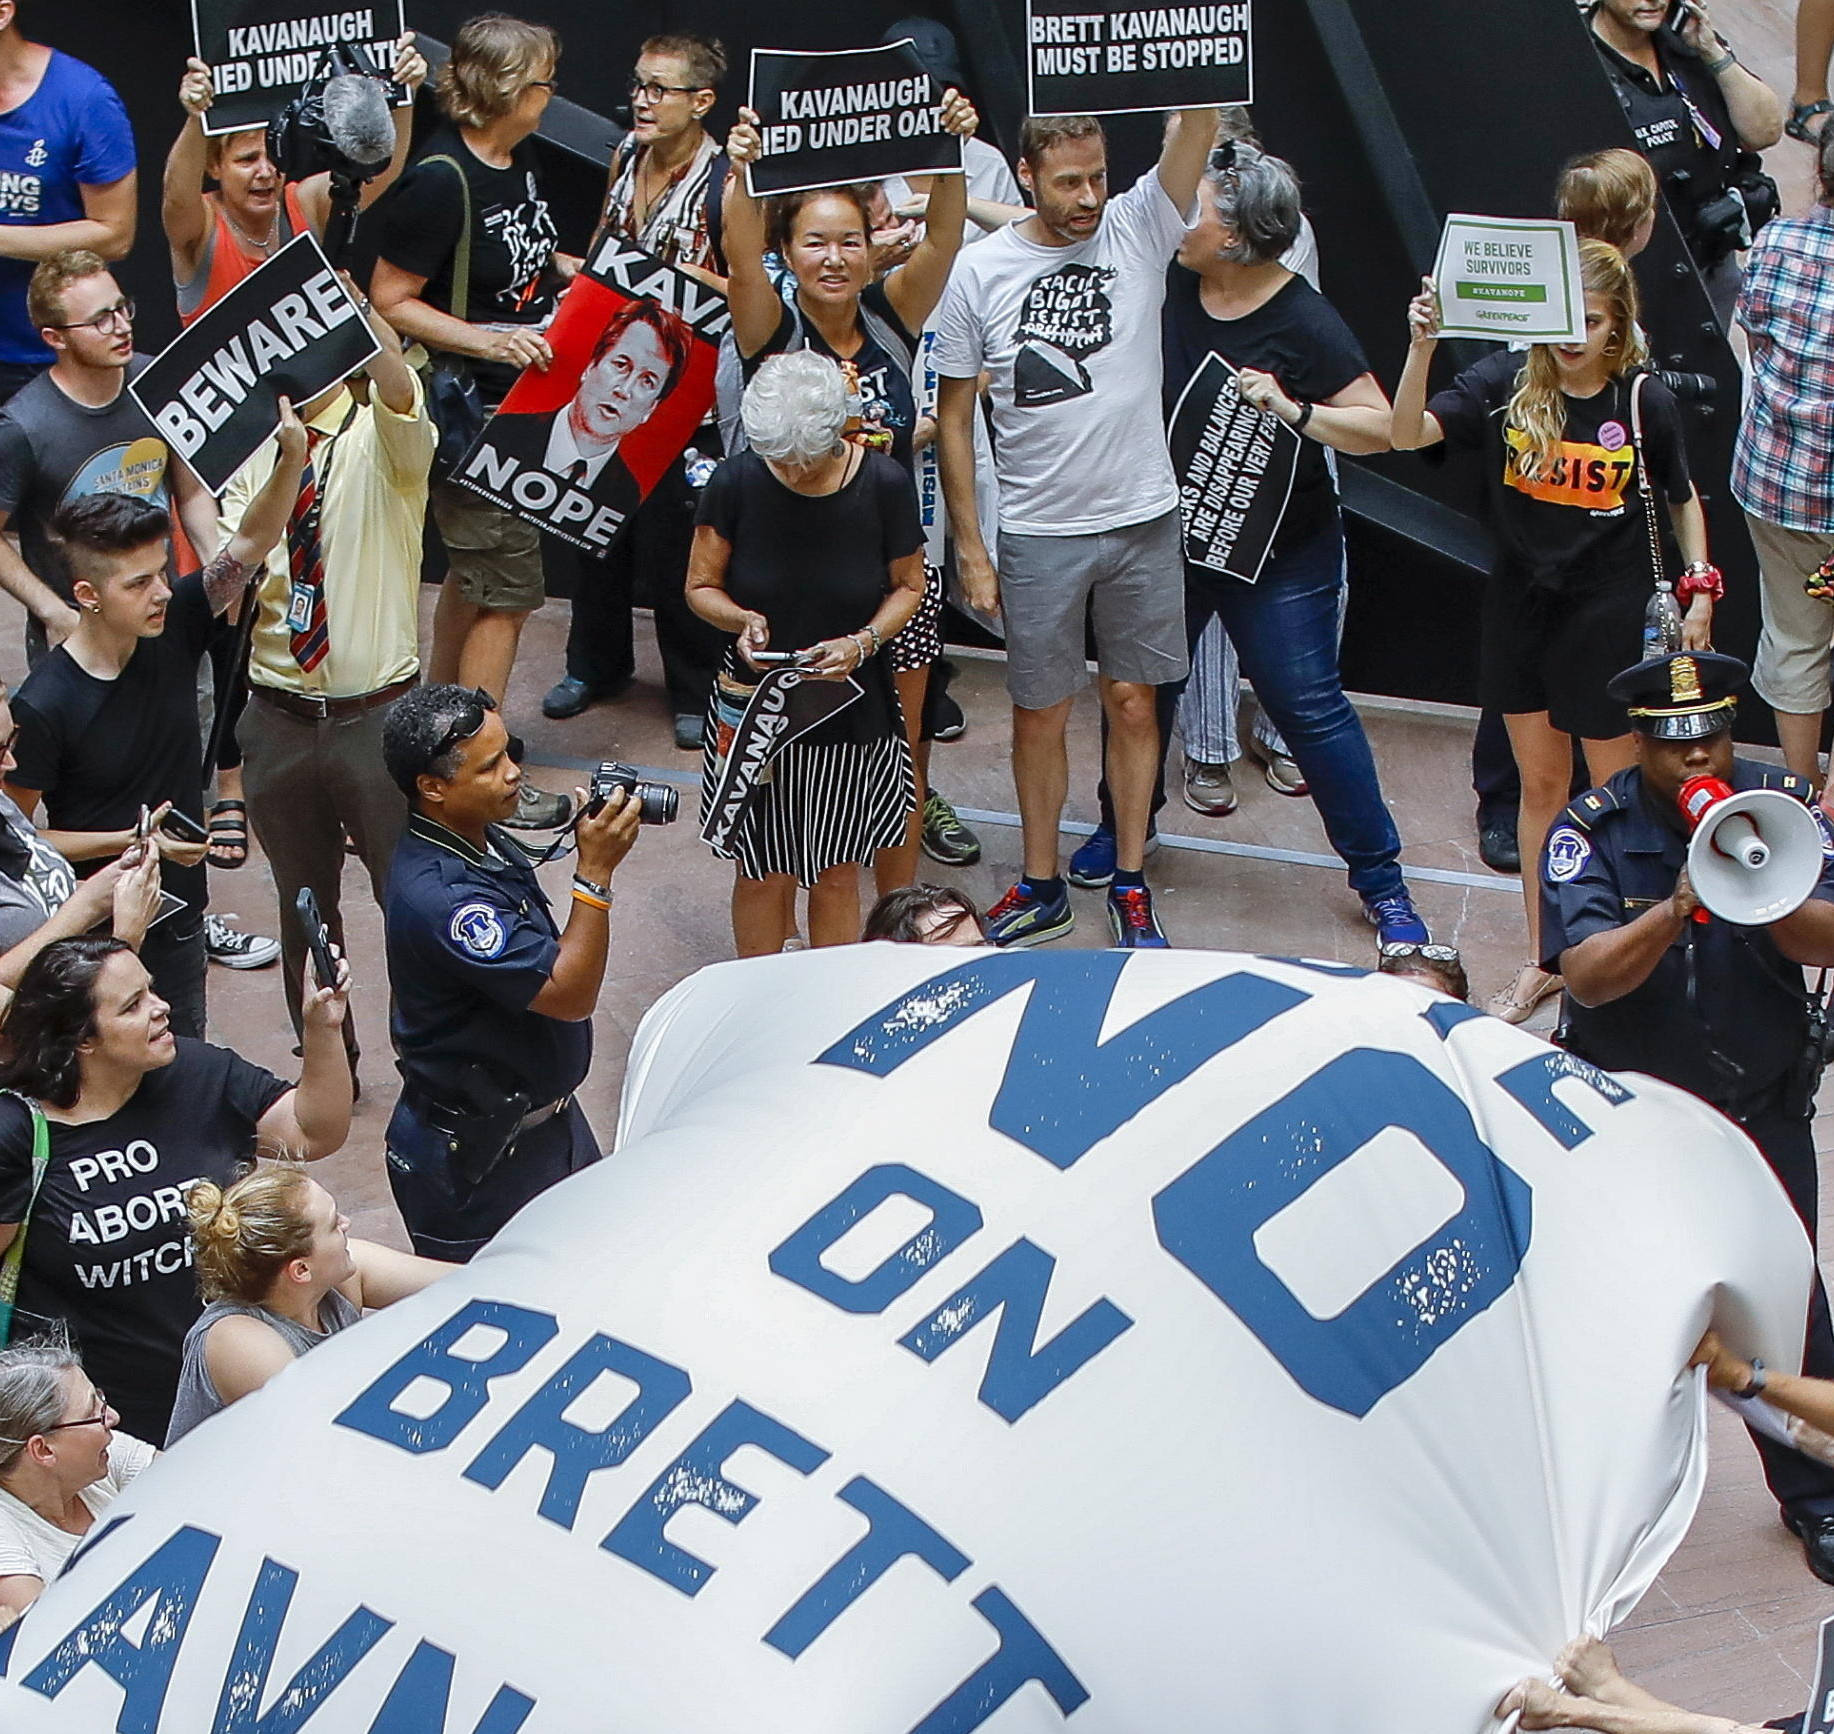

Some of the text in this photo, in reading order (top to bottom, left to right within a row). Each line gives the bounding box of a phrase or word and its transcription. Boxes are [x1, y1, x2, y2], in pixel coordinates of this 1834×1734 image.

[228, 8, 372, 57] KAVANAUGH
[1032, 5, 1247, 43] BRETT KAVANAUGH
[1036, 36, 1244, 75] MUST BE STOPPED
[781, 73, 929, 120] KAVANAUGH
[762, 108, 945, 157] IED UNDER OAT
[1464, 240, 1533, 259] WE BELIEVE
[1466, 259, 1531, 276] SURVIVORS
[1030, 290, 1095, 310] BIGOT
[156, 269, 354, 461] BEWARE
[1189, 446, 1214, 481] AND
[1191, 404, 1258, 543] ARE DISAPPEARING
[465, 443, 627, 548] NOPE
[1206, 437, 1267, 569] BEFORE OUR VERY
[69, 1138, 159, 1192] PRO
[770, 1162, 1135, 1426] ON
